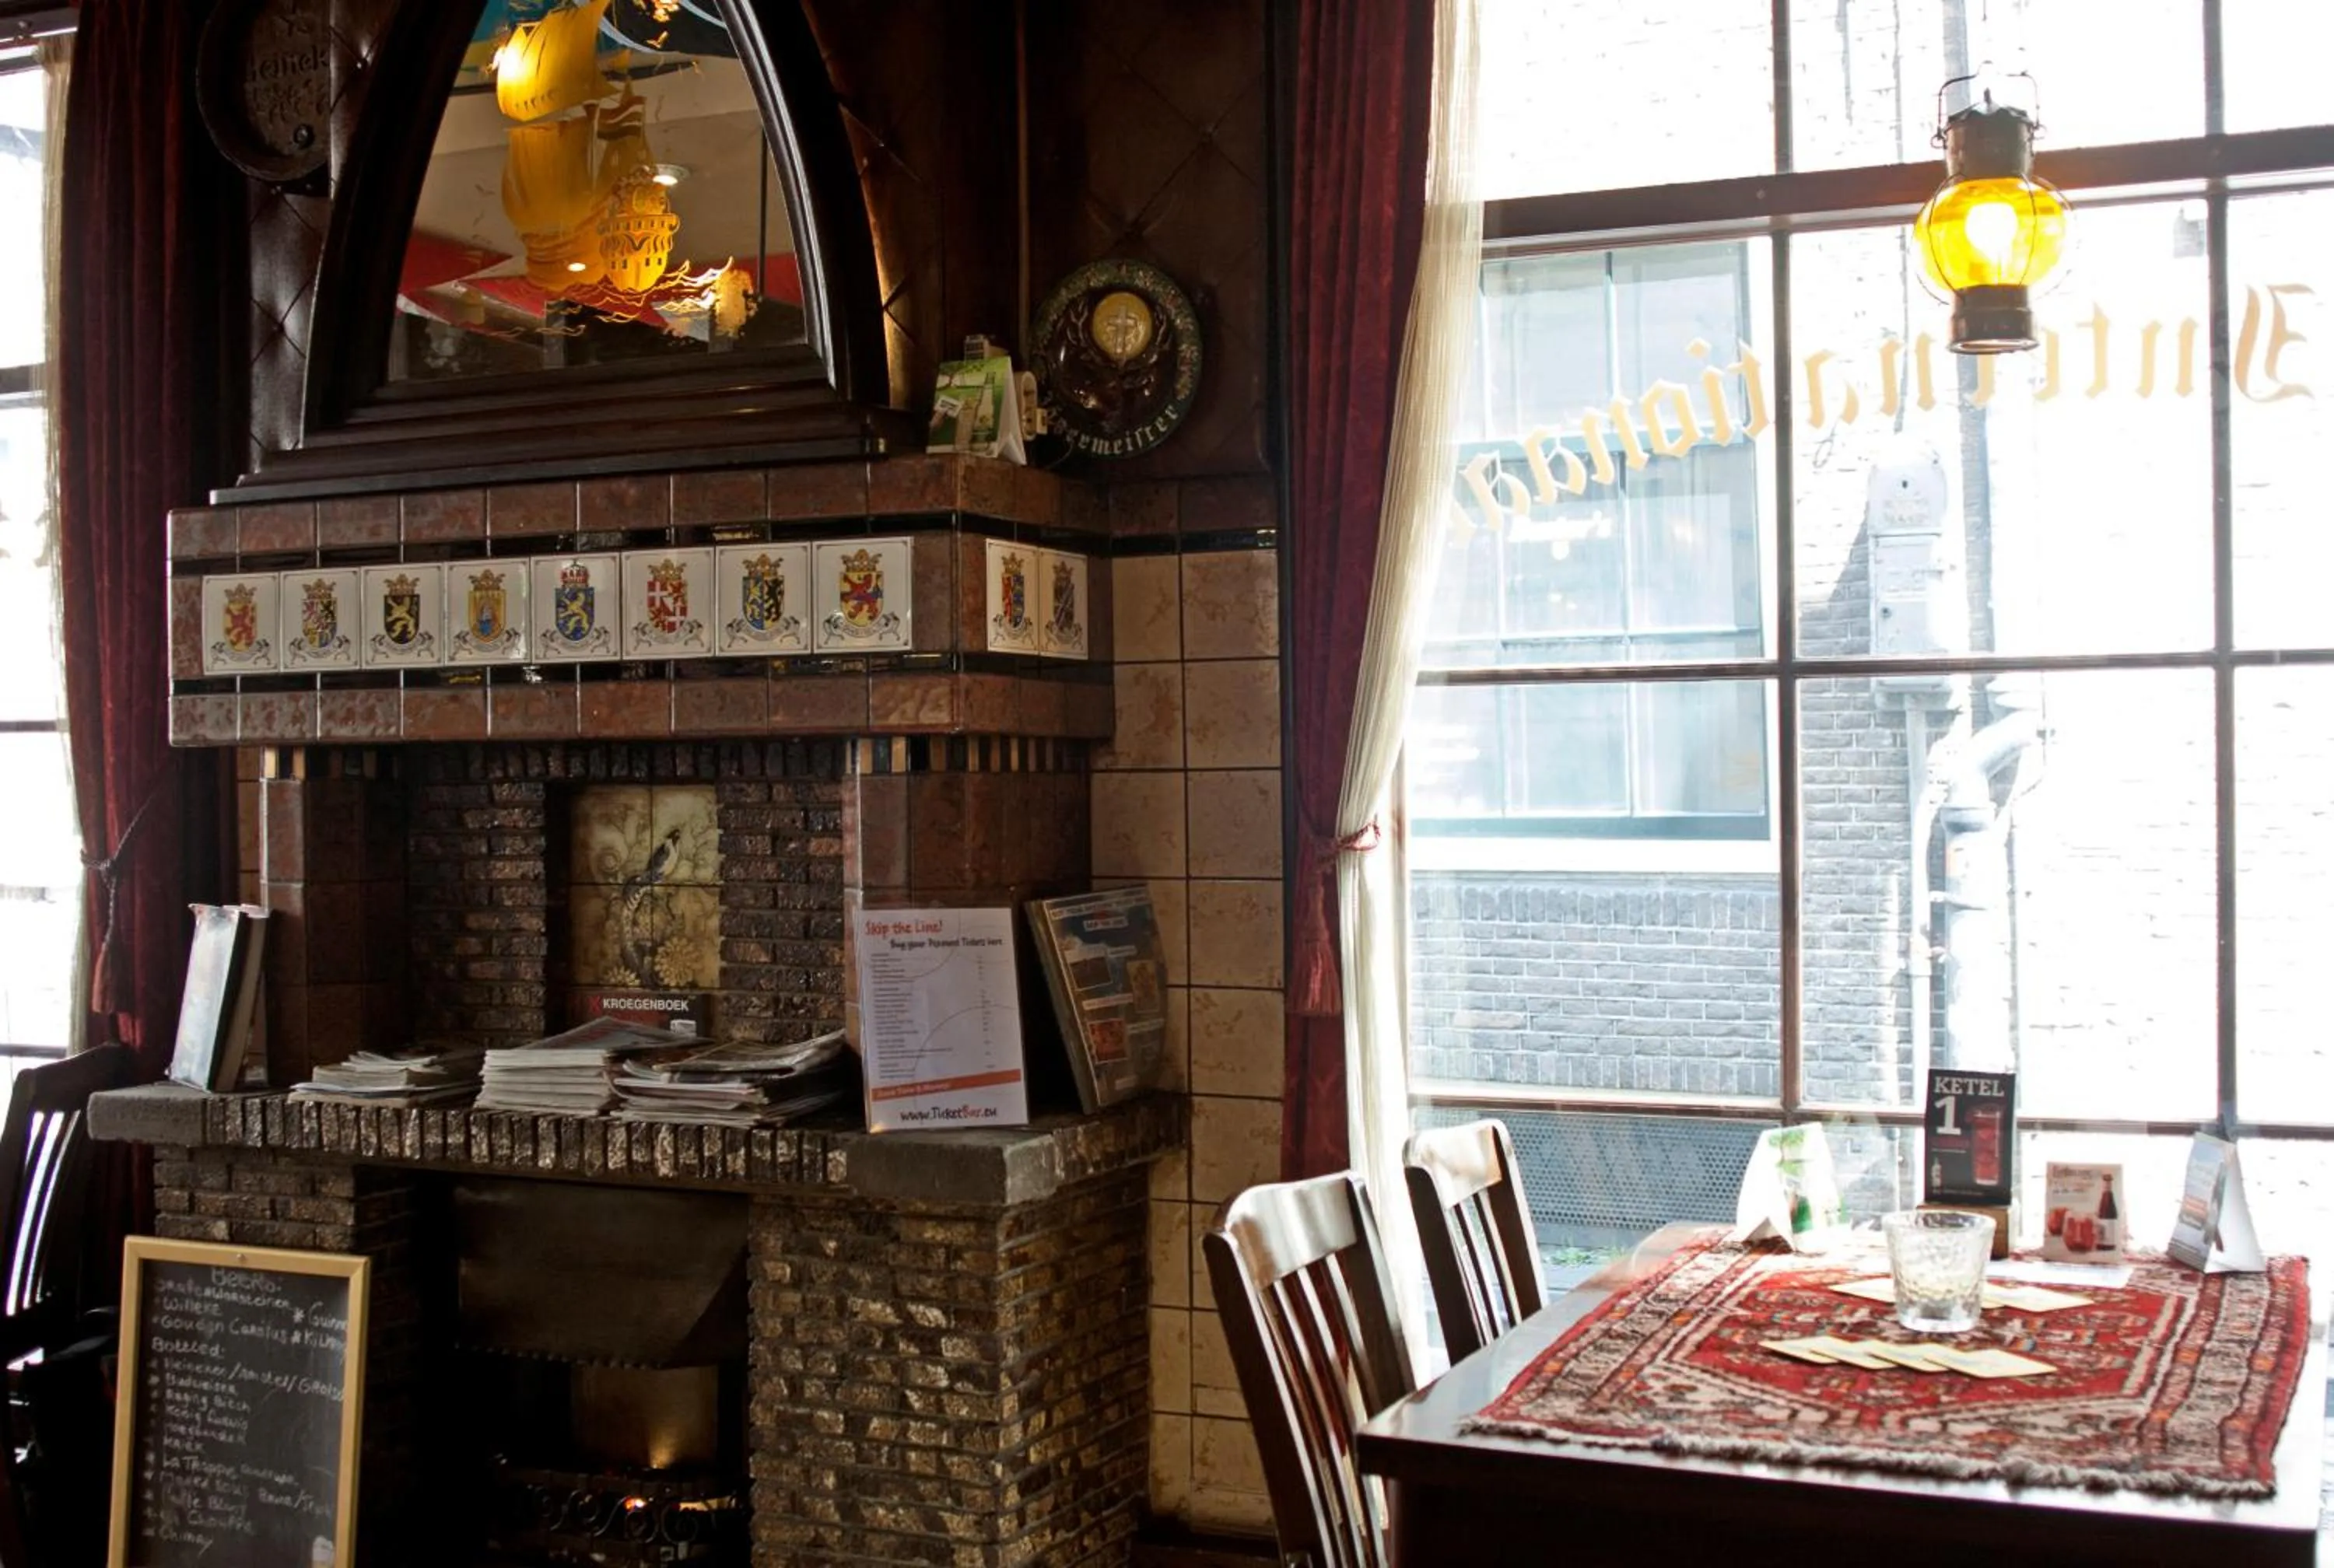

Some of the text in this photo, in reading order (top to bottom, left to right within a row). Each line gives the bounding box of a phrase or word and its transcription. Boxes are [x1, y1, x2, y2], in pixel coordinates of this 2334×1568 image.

[865, 918, 944, 938] Skip the Line!
[602, 997, 689, 1012] KROEGENBOEK
[1933, 1076, 2005, 1097] KETEL
[1934, 1094, 1962, 1136] 1
